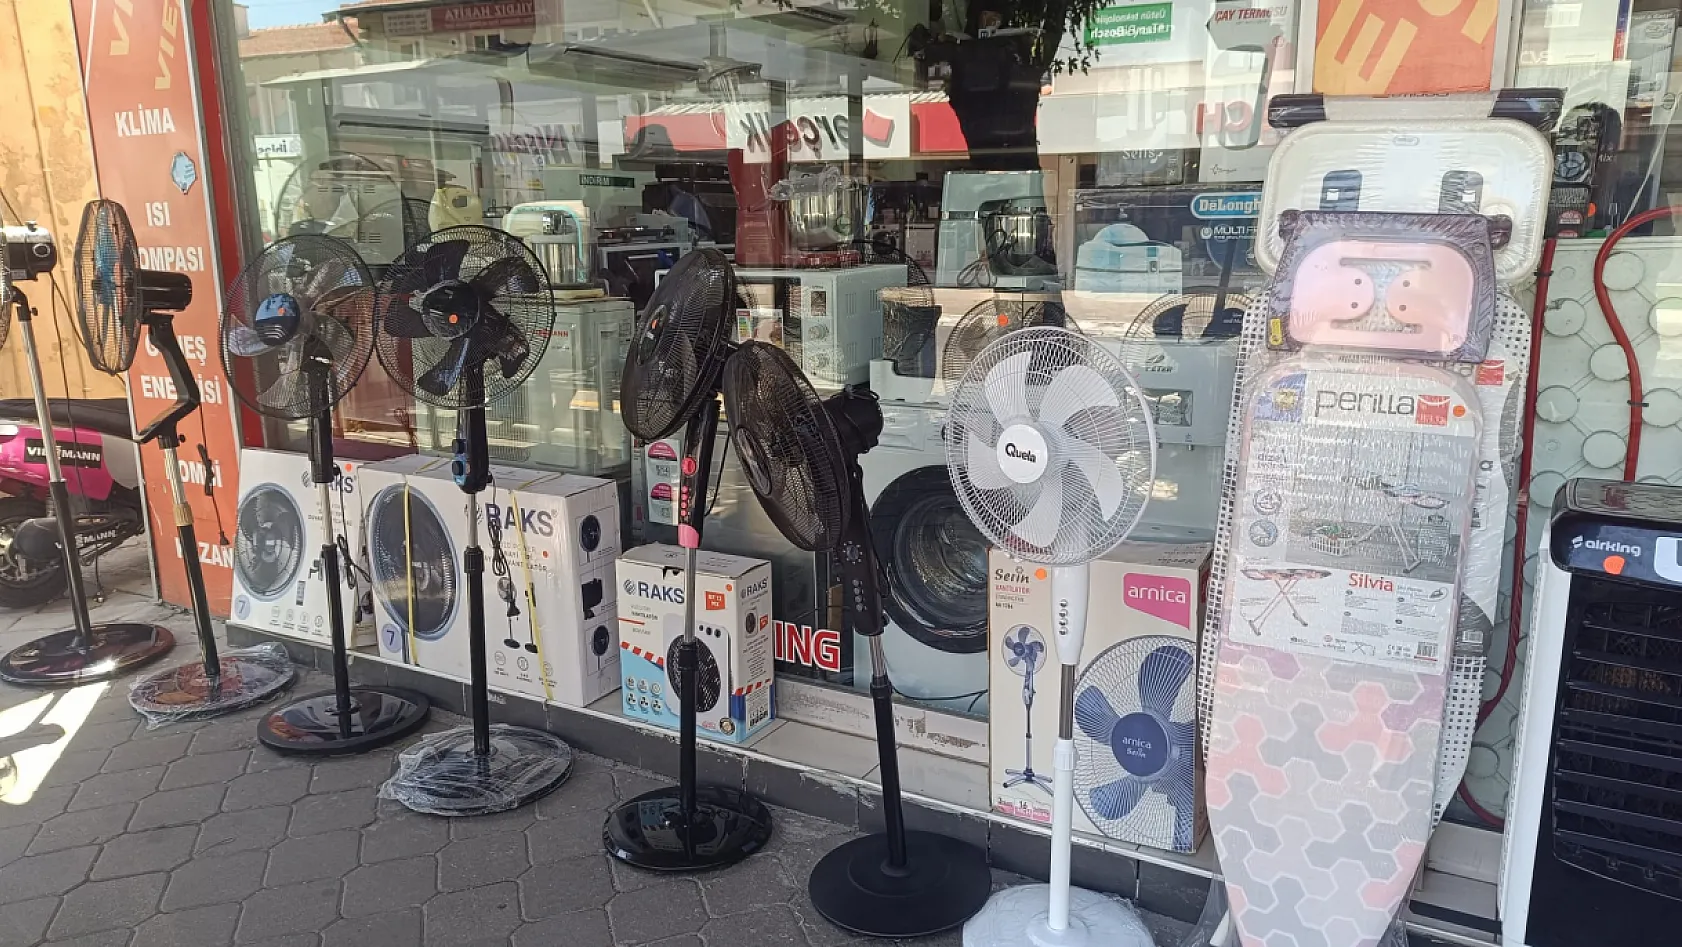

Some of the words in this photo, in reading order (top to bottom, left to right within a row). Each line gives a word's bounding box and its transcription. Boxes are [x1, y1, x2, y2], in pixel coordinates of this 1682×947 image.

[114, 103, 176, 137] KLİMA
[146, 202, 170, 226] ISI
[138, 247, 204, 272] OMPASI
[140, 373, 222, 404] ENEİSİ
[1315, 390, 1415, 418] perilla
[1005, 442, 1036, 463] Quela
[165, 459, 223, 487] OMİ
[485, 503, 554, 538] RAKS
[174, 537, 234, 569] ZAN
[1585, 540, 1641, 557] airking
[995, 566, 1030, 583] Serin
[1348, 572, 1394, 592] Silvia
[637, 580, 685, 604] RAKS
[746, 579, 767, 596] RAKS
[1127, 585, 1186, 604] arnica
[238, 600, 246, 614] 7
[386, 630, 395, 646] 7
[1122, 736, 1152, 749] arnica
